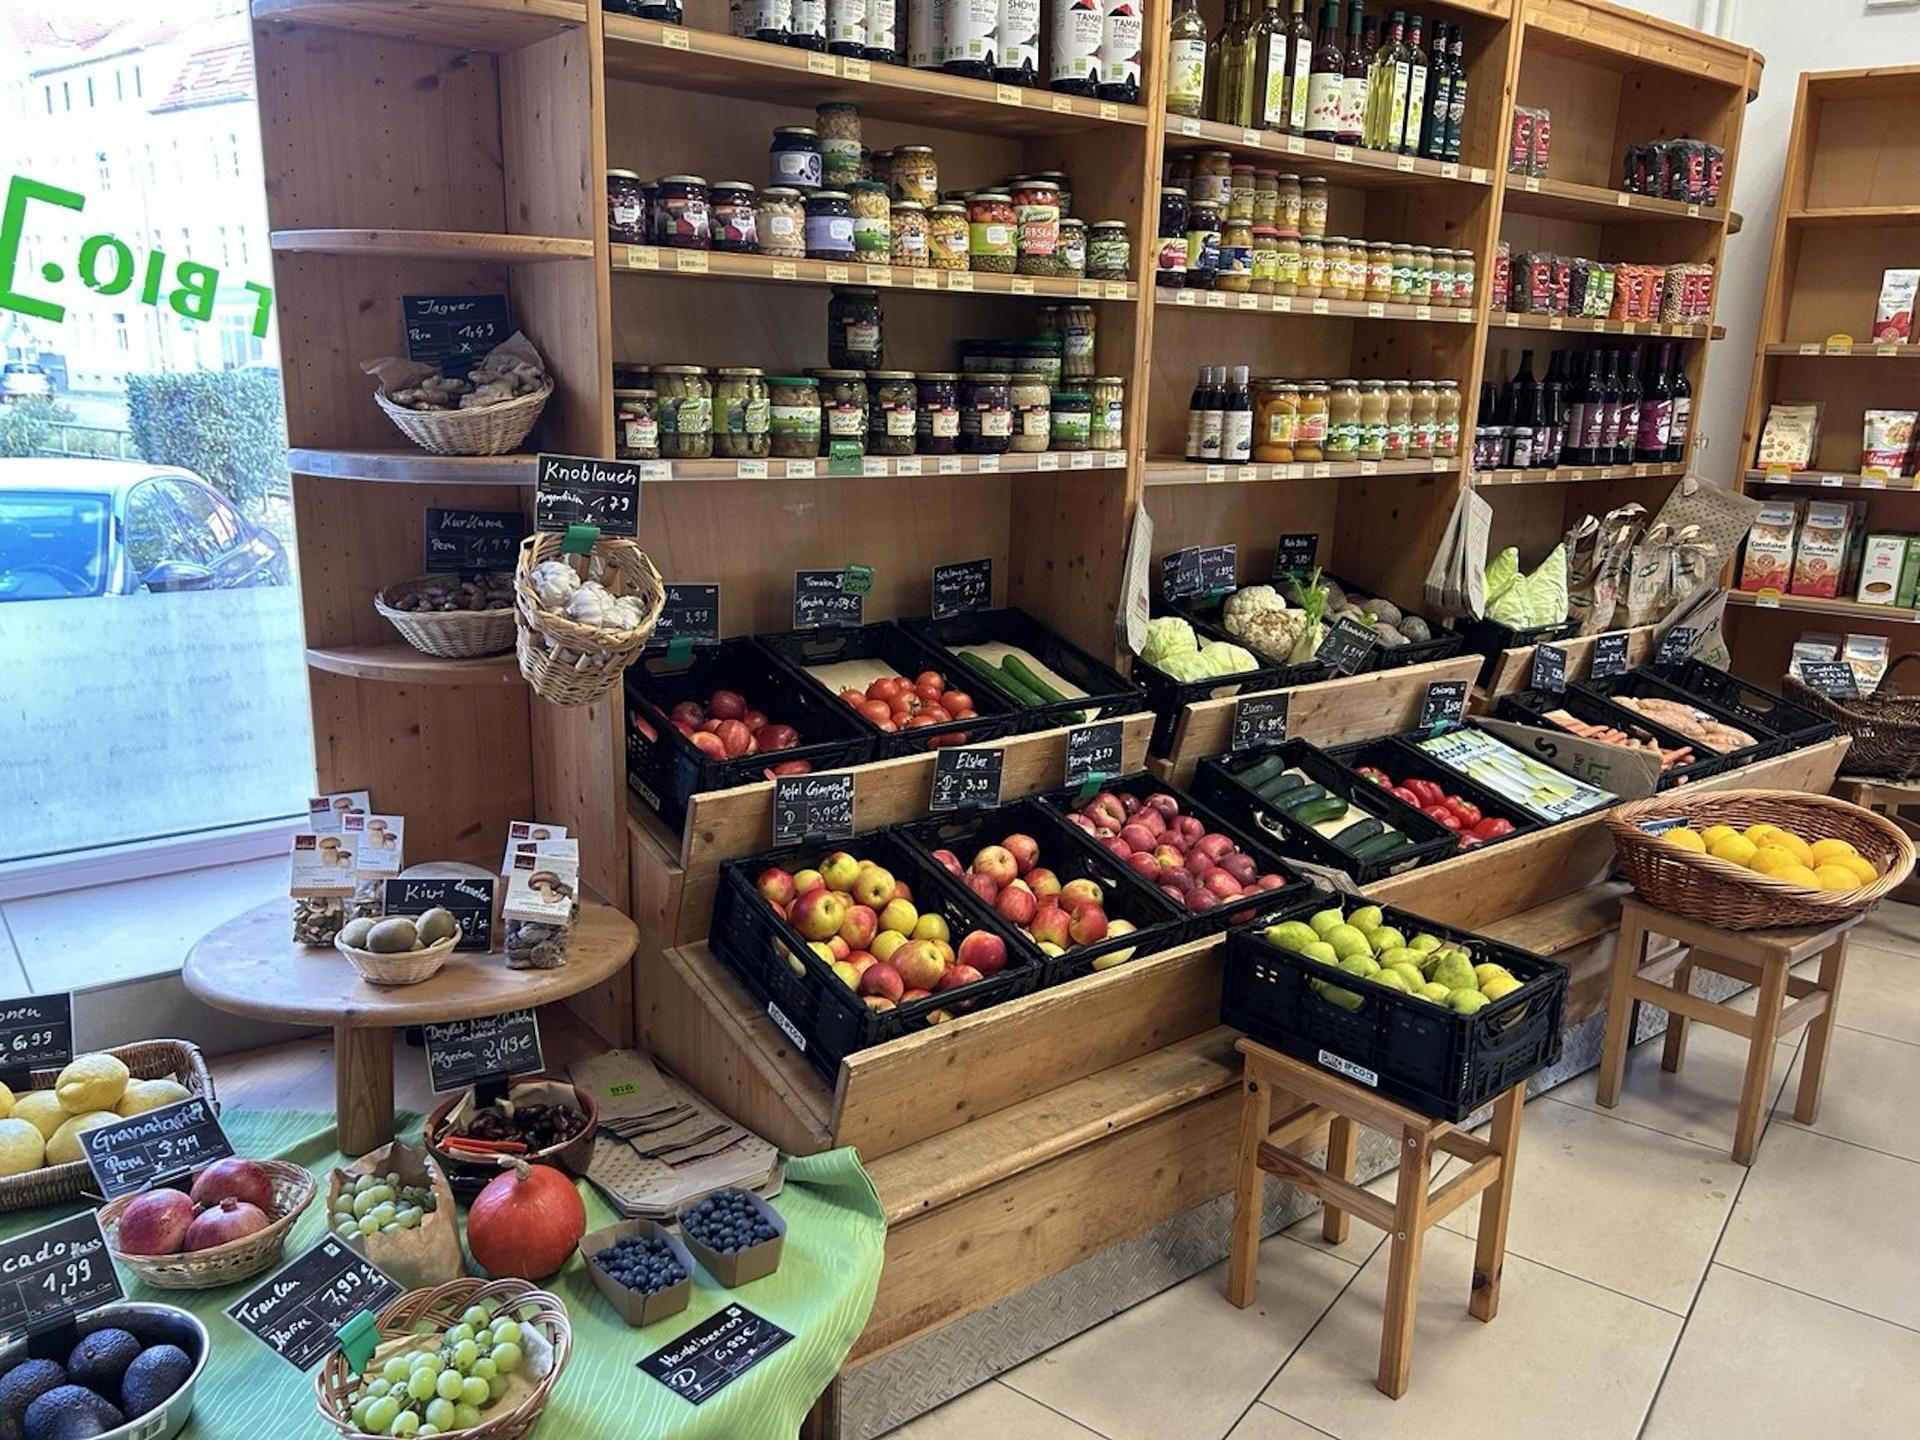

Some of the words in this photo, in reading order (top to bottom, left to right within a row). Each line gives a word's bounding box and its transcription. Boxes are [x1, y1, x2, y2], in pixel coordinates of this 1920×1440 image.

[544, 461, 637, 486] Knoblauch
[1751, 541, 1787, 551] Cornflakes
[1803, 544, 1839, 554] Cornflakes
[778, 782, 803, 801] Apfel
[404, 883, 445, 903] Kiwi
[12, 1030, 54, 1052] 6,99
[104, 1155, 146, 1175] Peru
[156, 1134, 200, 1159] 3,99
[70, 1238, 104, 1260] Hass
[42, 1258, 92, 1297] 1,99
[321, 1271, 361, 1307] 7,99
[236, 1280, 301, 1324] Trauben
[659, 1317, 744, 1368] Heidelbeeren
